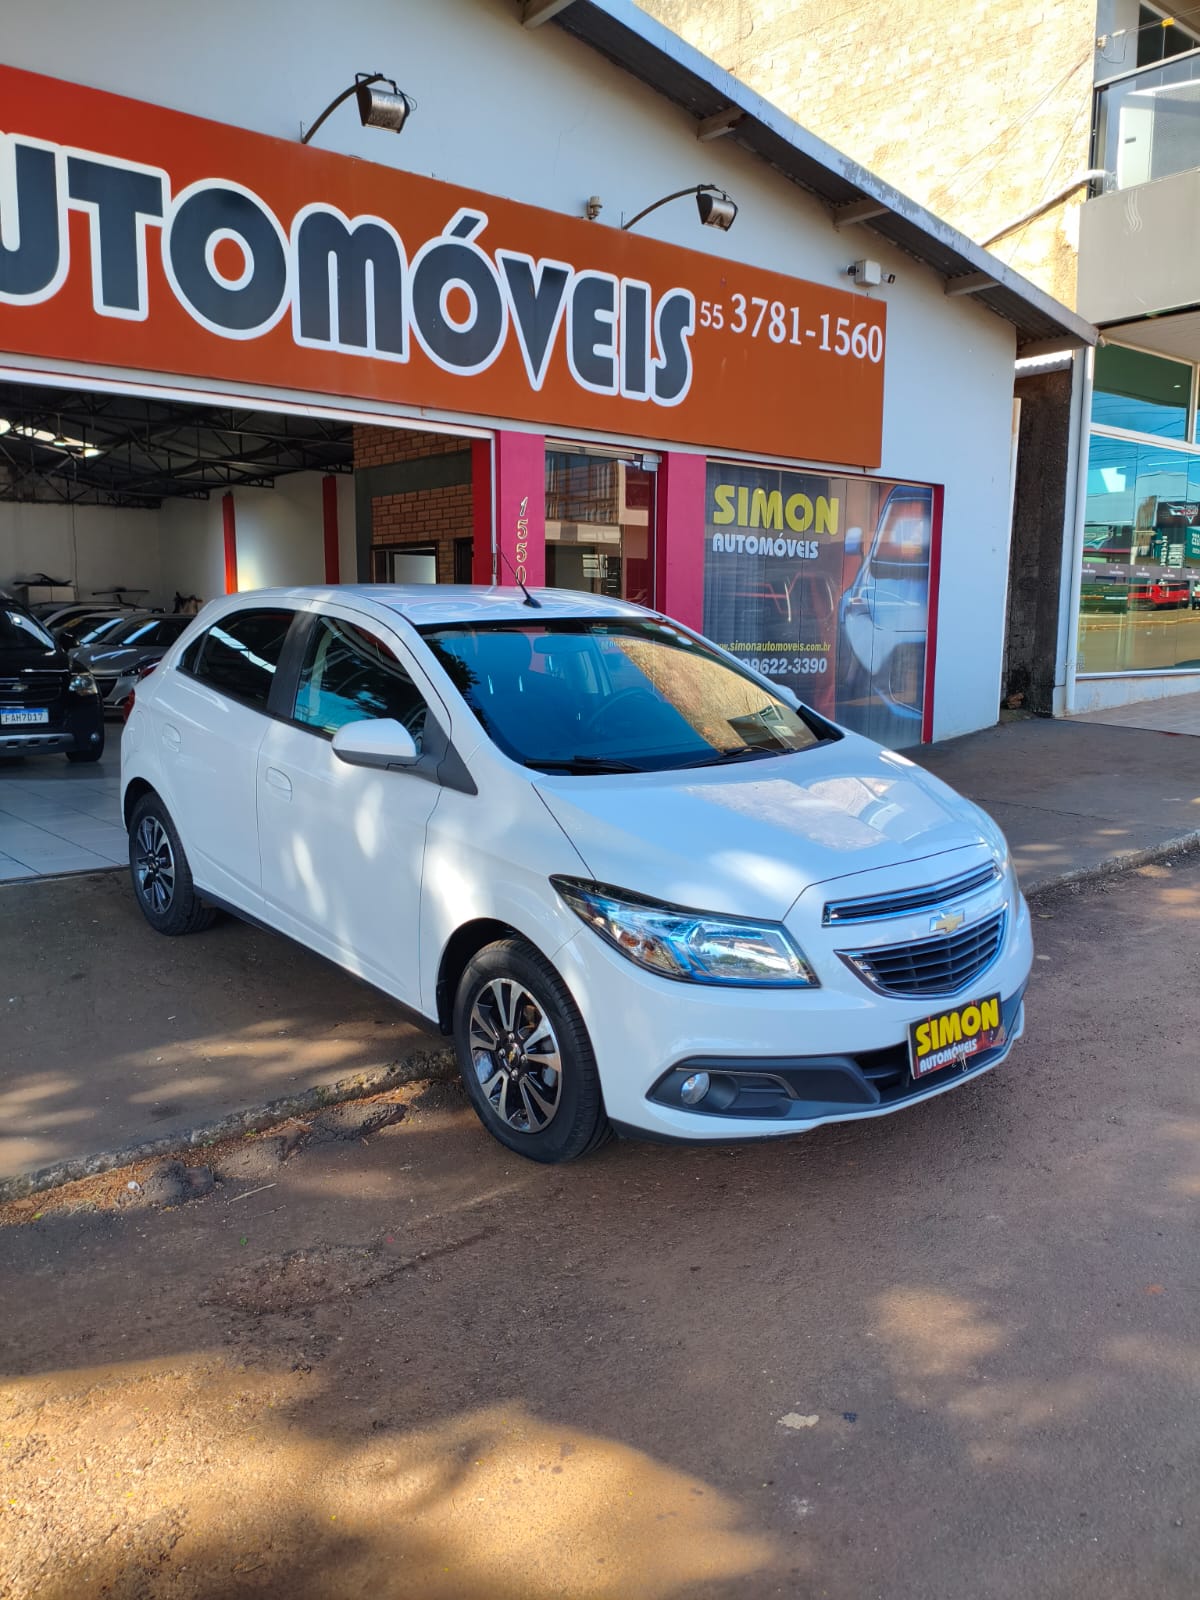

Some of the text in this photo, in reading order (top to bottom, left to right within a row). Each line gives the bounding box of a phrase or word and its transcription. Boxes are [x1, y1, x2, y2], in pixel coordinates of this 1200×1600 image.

[700, 293, 883, 363] 55 3781-1560
[713, 484, 839, 536] SIMON
[515, 496, 529, 586] 1550
[712, 533, 819, 559] AUTOMÓVEIS
[915, 998, 999, 1057] SIMON
[920, 1038, 977, 1073] AUTOMÓVEIS
